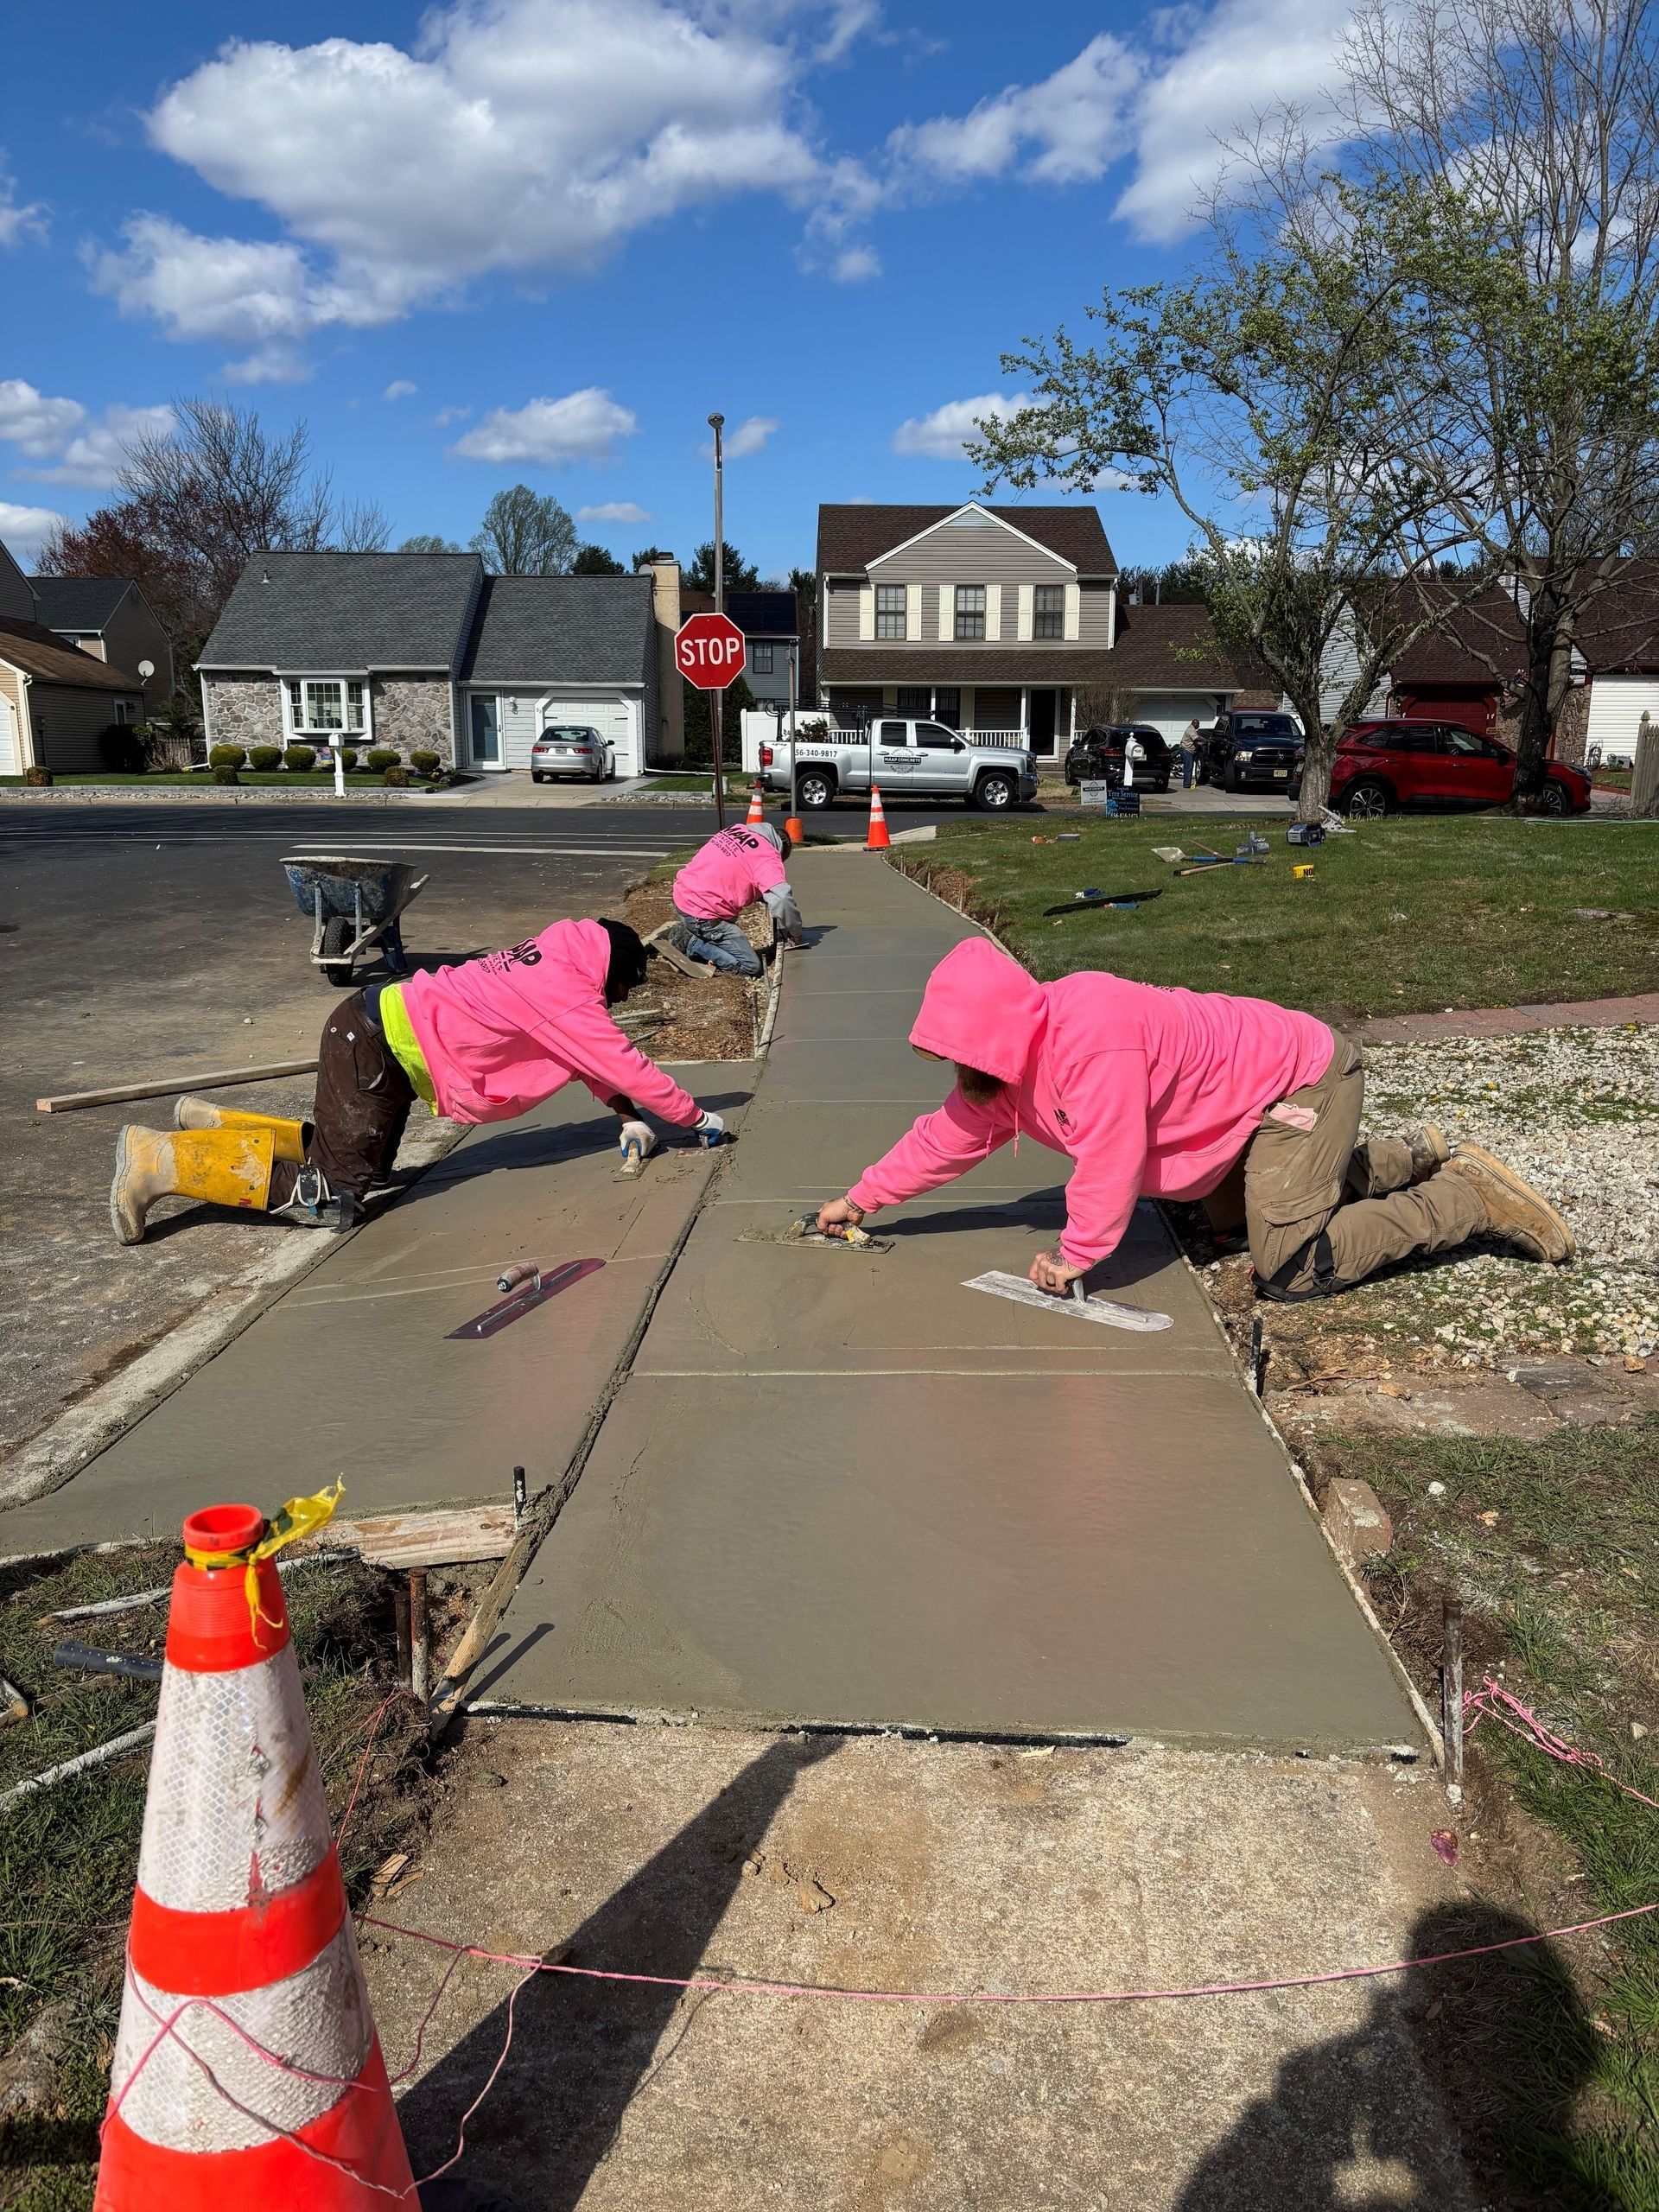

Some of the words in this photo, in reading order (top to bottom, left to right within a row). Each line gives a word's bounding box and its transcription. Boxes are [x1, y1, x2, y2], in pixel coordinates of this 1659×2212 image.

[680, 637, 741, 666] STOP
[794, 748, 838, 758] 56-340-9817
[1107, 789, 1120, 798] Tree
[1120, 790, 1139, 798] Service
[722, 827, 760, 849] MAAP
